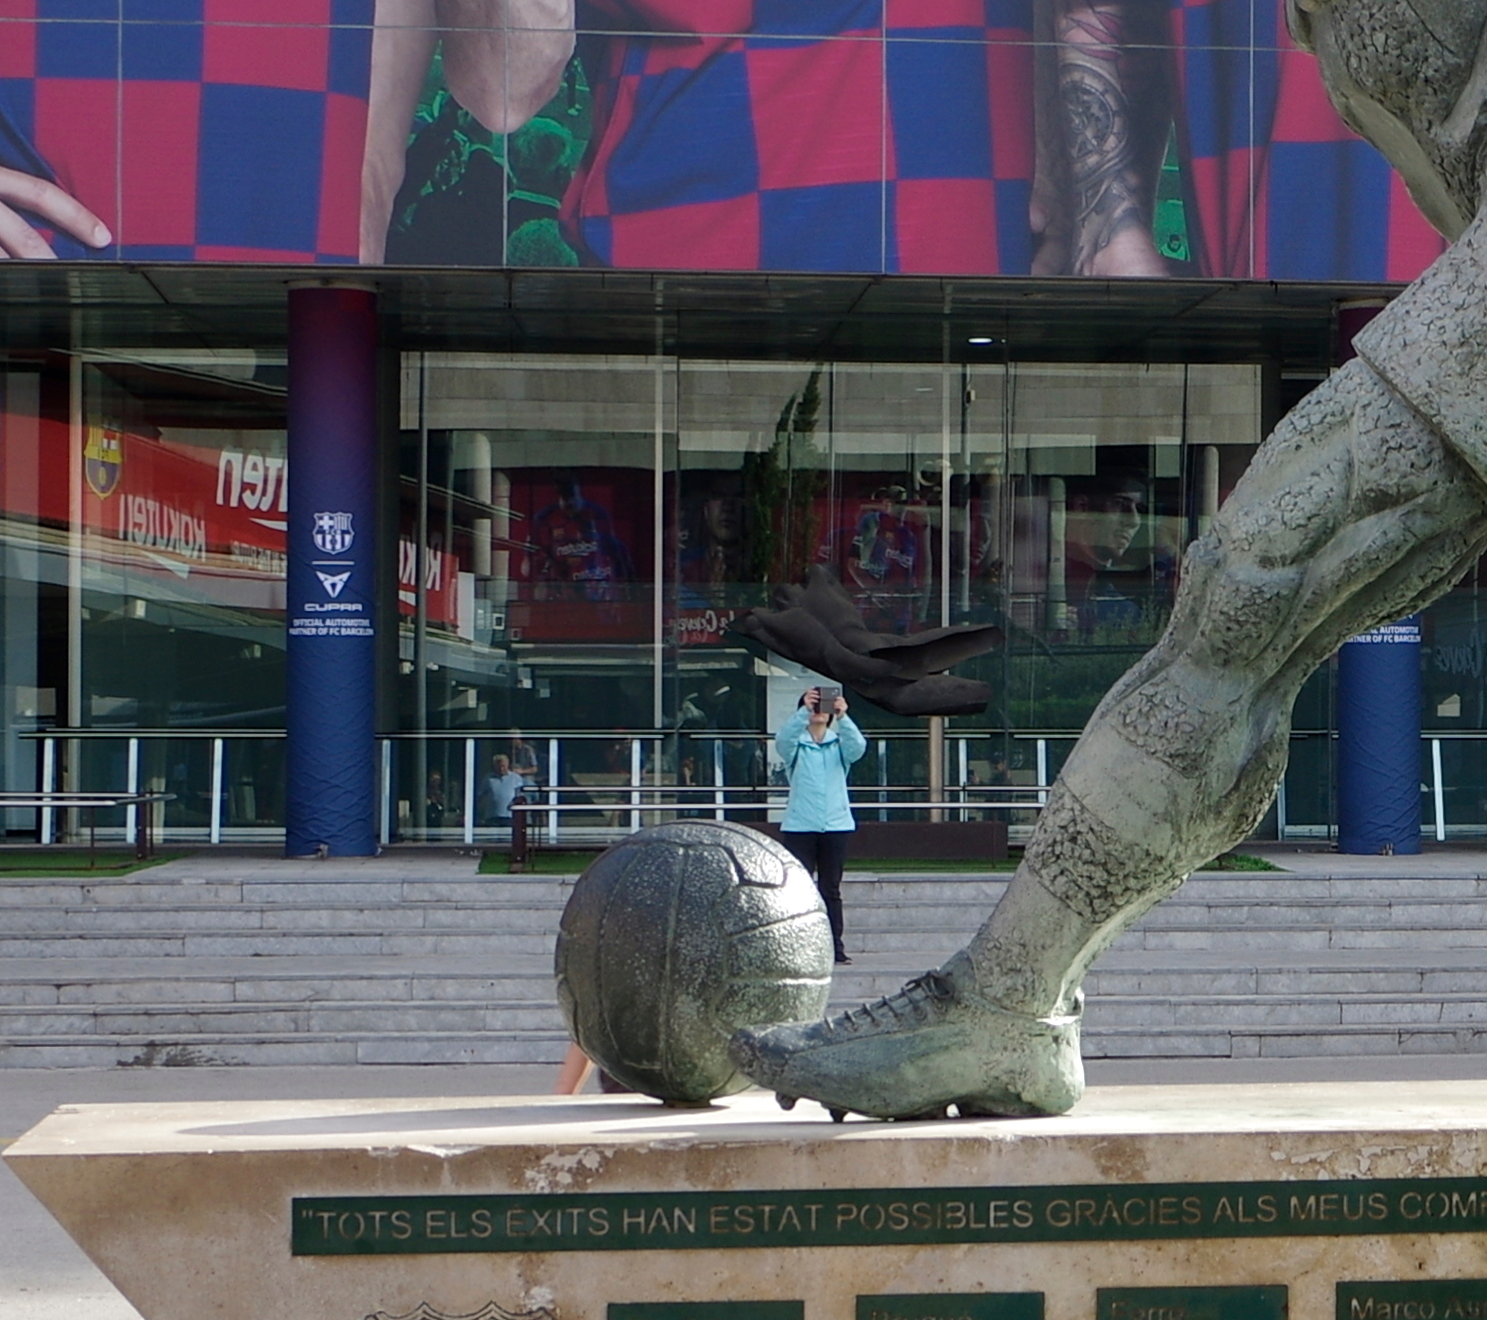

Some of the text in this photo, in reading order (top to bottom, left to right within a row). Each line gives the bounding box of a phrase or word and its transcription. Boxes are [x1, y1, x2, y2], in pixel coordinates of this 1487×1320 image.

[304, 603, 362, 611] CUPRA
[1373, 635, 1393, 643] OF FC
[425, 1209, 492, 1239] ELS
[622, 1207, 697, 1235] HAN
[710, 1204, 819, 1234] ESTAT
[836, 1201, 1034, 1231] POSSIBLES
[1214, 1196, 1279, 1224] ALS
[1289, 1193, 1389, 1221] MEUS
